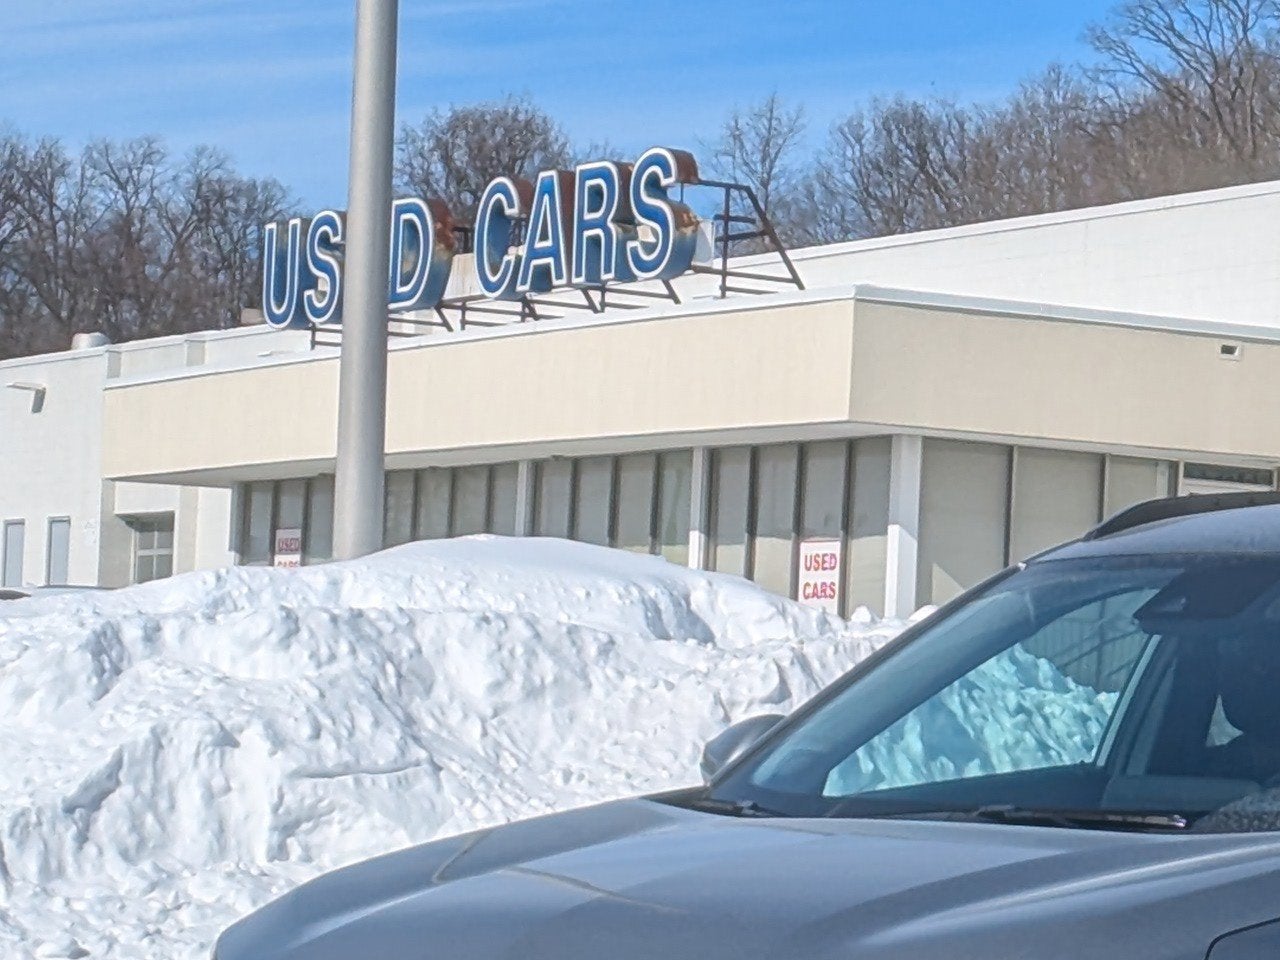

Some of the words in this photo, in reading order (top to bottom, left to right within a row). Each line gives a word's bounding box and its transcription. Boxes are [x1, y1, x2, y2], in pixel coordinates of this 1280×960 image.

[263, 197, 433, 329] USD
[474, 147, 678, 298] CARS
[278, 538, 299, 552] USED
[805, 553, 837, 571] USED
[803, 581, 836, 599] CARS
